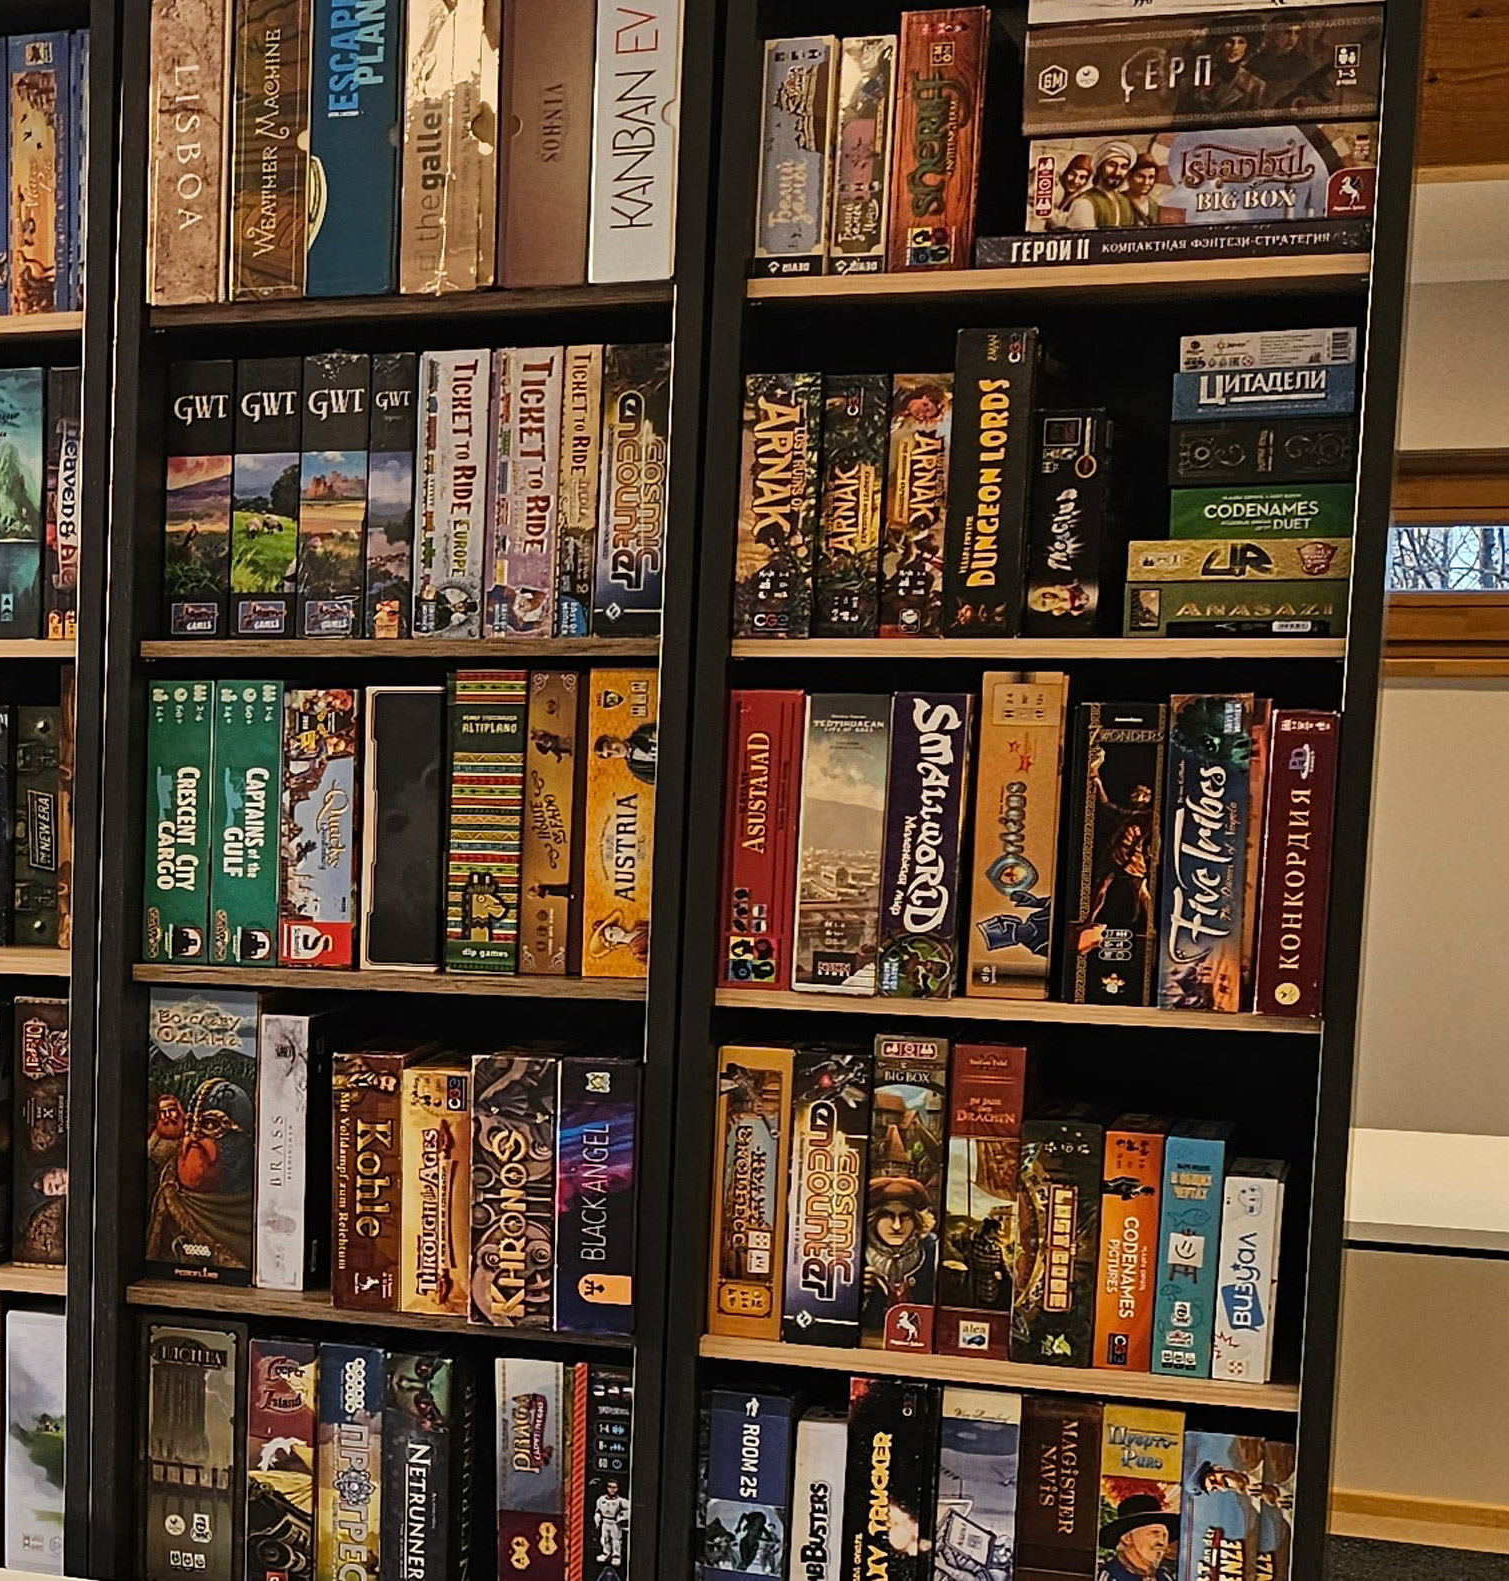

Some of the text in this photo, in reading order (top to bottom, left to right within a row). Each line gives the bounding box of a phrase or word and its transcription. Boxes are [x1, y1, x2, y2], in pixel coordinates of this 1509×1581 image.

[174, 63, 204, 231] LISBOA
[247, 28, 290, 258] WEATHER MACHINE
[610, 8, 658, 230] KANBAN EV
[416, 195, 440, 244] the
[1196, 188, 1296, 212] BIG BOX
[1101, 238, 1187, 254] КОМПАКТНАЯ
[173, 394, 229, 426] GWT
[240, 391, 297, 423] GWT
[307, 388, 366, 421] GWT
[375, 390, 412, 411] GWT
[518, 355, 555, 462] TICKET
[571, 351, 592, 415] TICKET
[1198, 369, 1328, 406] ЦИТАДЕЛИ
[449, 358, 479, 578] TICKET TO RIDE EUROPE
[527, 466, 545, 489] TO
[570, 435, 592, 477] RIDE
[750, 395, 802, 537] ARNAK
[907, 430, 944, 524] ARNAK
[966, 378, 1011, 588] DUNGEON LORDS
[523, 494, 551, 554] RIDE
[828, 464, 861, 556] ARNAK
[1203, 501, 1319, 520] CODENAMES
[1272, 517, 1312, 531] DUET
[1175, 602, 1333, 618] ANASAZI
[462, 721, 518, 735] ALTIPLANO
[1097, 728, 1165, 744] WONDERS
[40, 796, 52, 852] NEW ERA
[175, 766, 201, 892] CRESCENT CITY
[244, 767, 270, 849] CAPTAINS
[741, 732, 770, 855] ASUSTAJAD
[156, 820, 176, 891] CARGO
[223, 826, 244, 878] GULF
[613, 793, 640, 903] AUSTRIA
[1168, 763, 1233, 965] Five Tribes
[1278, 787, 1313, 970] КОНКОРДИЯ
[884, 1070, 931, 1085] BIG BOX
[269, 1114, 284, 1187] BRASS
[956, 1110, 1017, 1125] DRACHEN
[355, 1118, 394, 1239] Kohle
[416, 1129, 440, 1297] THROUGH AGES
[580, 1123, 611, 1262] BLACK ANGEL
[490, 1128, 528, 1318] KHRONOS
[1106, 1238, 1121, 1295] PICTURES
[1118, 1215, 1141, 1320] CODENAMES
[962, 1324, 987, 1335] alea
[739, 1422, 760, 1499] ROOM 25
[868, 1431, 893, 1537] TRUCKER
[408, 1441, 432, 1580] NETRUNNER
